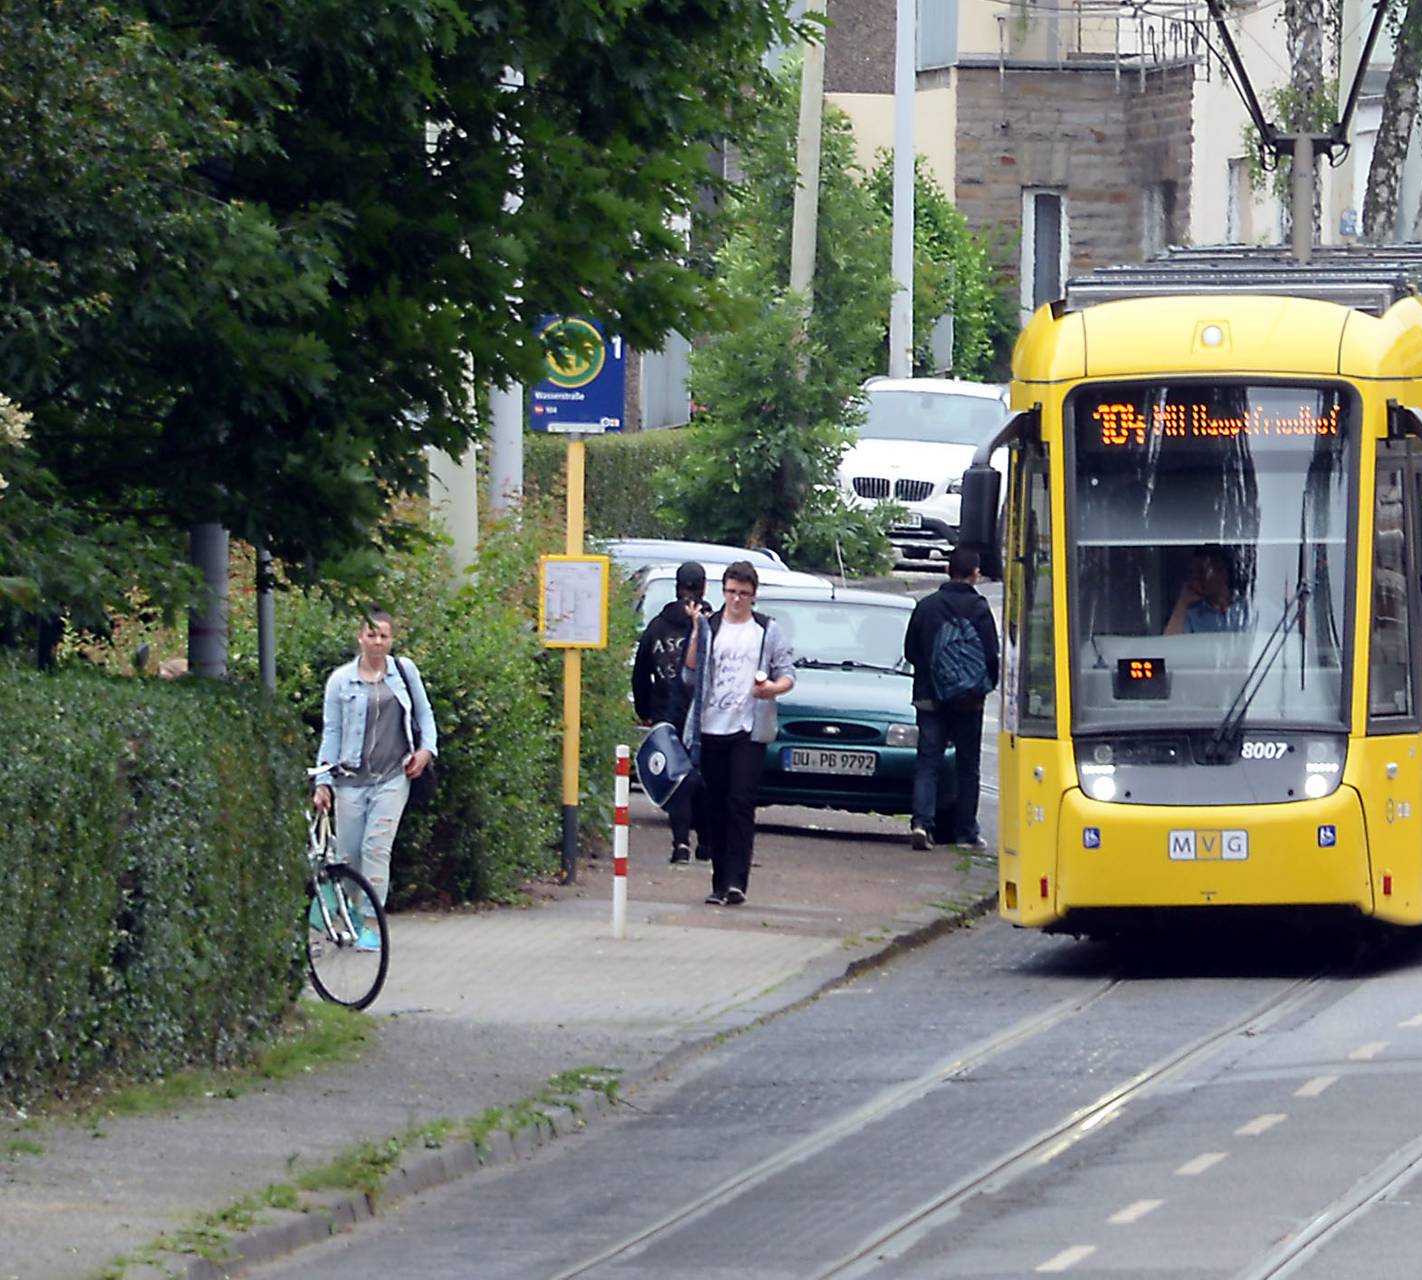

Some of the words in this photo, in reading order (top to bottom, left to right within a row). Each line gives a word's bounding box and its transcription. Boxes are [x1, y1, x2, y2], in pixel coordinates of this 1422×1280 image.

[611, 335, 621, 358] 1
[535, 391, 585, 401] Wasserstraße
[1241, 742, 1287, 759] 8007
[793, 751, 809, 766] DU
[820, 753, 837, 768] PB
[841, 754, 874, 770] 9792
[1172, 836, 1242, 853] MVG
